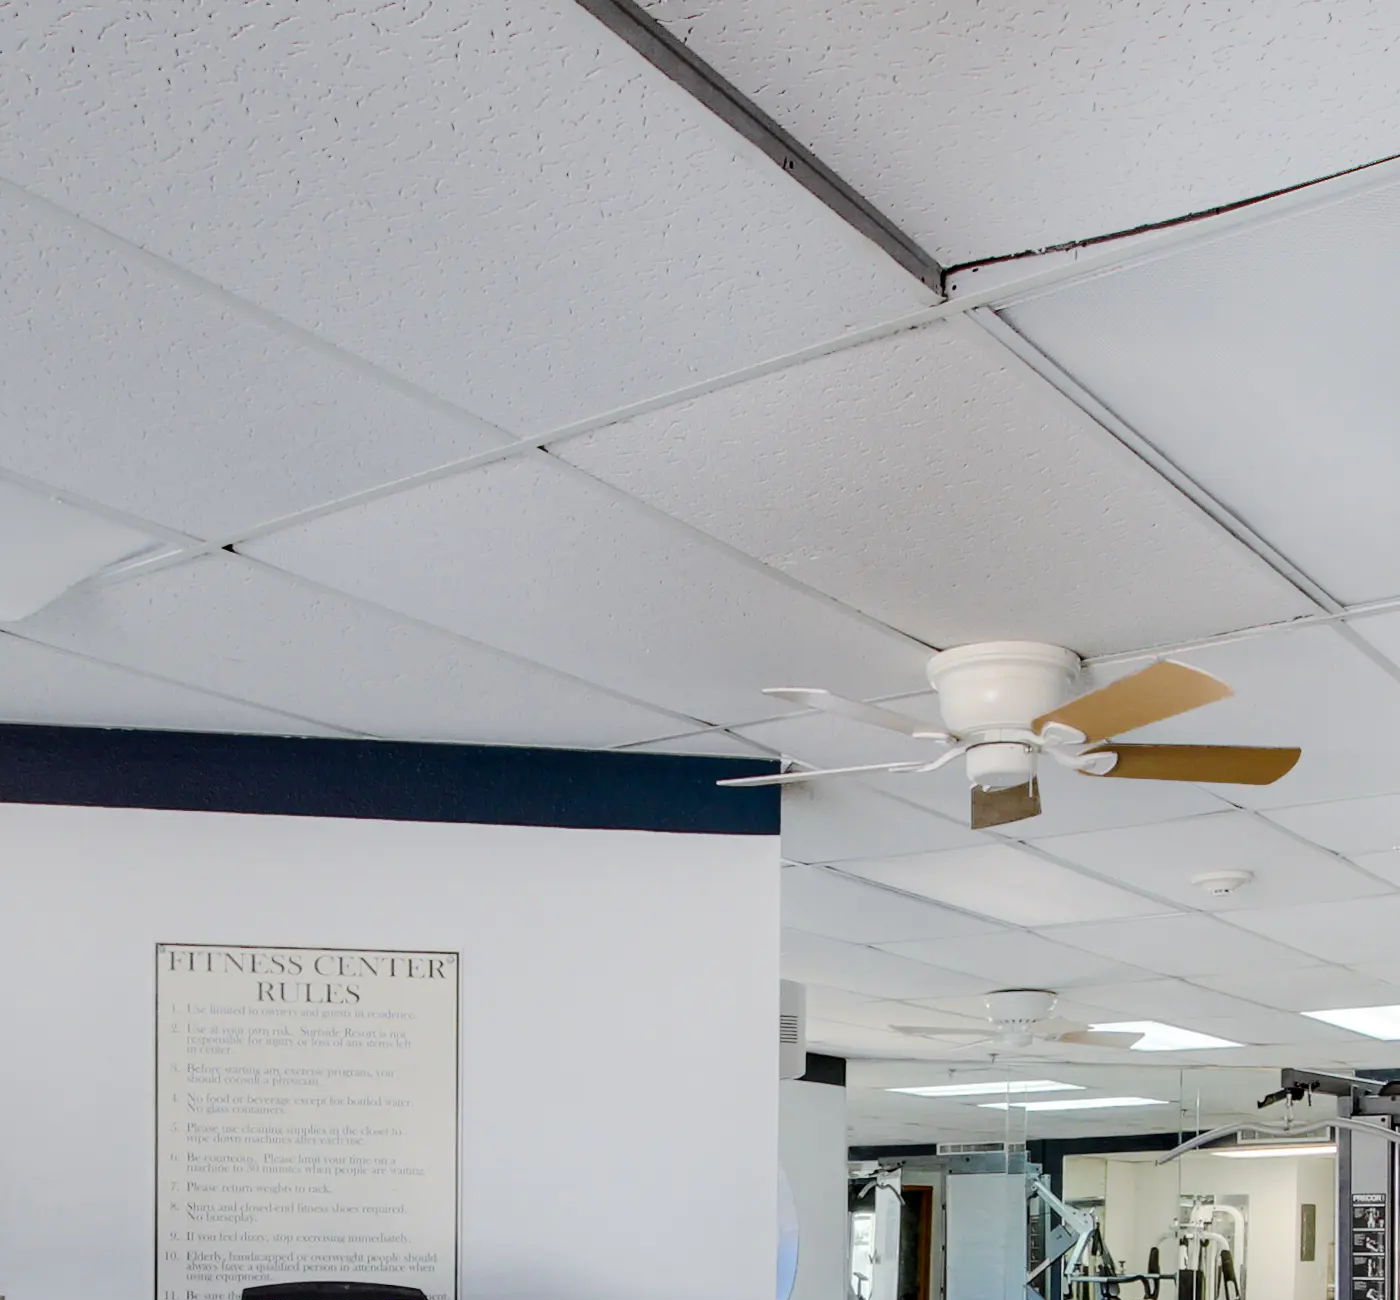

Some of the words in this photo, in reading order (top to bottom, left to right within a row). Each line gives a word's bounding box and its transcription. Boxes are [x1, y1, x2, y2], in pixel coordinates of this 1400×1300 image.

[168, 951, 304, 976] FITNESS
[314, 955, 447, 980] CENTER
[257, 981, 361, 1004] RULES
[209, 1004, 245, 1015] limited
[300, 1006, 318, 1017] and
[187, 1063, 220, 1073] Before
[225, 1065, 260, 1075] starting
[264, 1068, 280, 1076] any
[284, 1068, 322, 1076] exercise
[376, 1069, 394, 1078] you
[187, 1074, 221, 1084] should
[207, 1094, 229, 1103] food
[247, 1095, 289, 1105] beverage
[294, 1097, 326, 1106] except
[330, 1096, 345, 1105] for
[348, 1096, 382, 1106] bottled
[206, 1104, 228, 1114] glass
[232, 1104, 286, 1113] containers.
[187, 1122, 218, 1133] Please
[241, 1124, 283, 1135] cleaning
[286, 1124, 326, 1136] supplies
[343, 1125, 357, 1135] the
[360, 1126, 389, 1136] closet
[186, 1134, 210, 1144] wipe
[214, 1134, 242, 1143] down
[245, 1134, 291, 1144] machines
[294, 1135, 316, 1144] after
[321, 1136, 342, 1145] each
[264, 1153, 293, 1163] Please
[298, 1155, 320, 1164] limit
[324, 1157, 346, 1165] your
[349, 1155, 371, 1164] time
[187, 1163, 229, 1172] machine
[262, 1165, 301, 1173] minutes
[305, 1165, 331, 1174] when
[335, 1166, 366, 1176] people
[187, 1182, 218, 1192] Please
[222, 1184, 253, 1192] return
[256, 1184, 291, 1193] weights
[187, 1202, 214, 1212] Shirts
[218, 1202, 237, 1212] and
[240, 1203, 294, 1213] closed-end
[298, 1203, 328, 1213] fitness
[331, 1203, 359, 1213] shoes
[362, 1204, 407, 1217] required.
[206, 1212, 258, 1223] horseplay.
[197, 1234, 216, 1242] you
[220, 1232, 237, 1241] feel
[241, 1232, 269, 1242] dizzy,
[273, 1234, 293, 1243] stop
[297, 1234, 345, 1243] exercising
[348, 1232, 411, 1243] immediately.
[165, 1251, 179, 1261] 10.
[187, 1251, 226, 1262] Elderly,
[229, 1252, 294, 1263] handicapped
[311, 1252, 364, 1263] overweight
[367, 1253, 400, 1264] people
[404, 1253, 437, 1263] should
[186, 1261, 218, 1272] always
[222, 1262, 243, 1271] have
[257, 1262, 299, 1273] qualified
[303, 1263, 337, 1273] person
[353, 1263, 404, 1272] attendance
[408, 1263, 435, 1272] when
[186, 1273, 212, 1281] using
[216, 1272, 272, 1282] equipment.
[165, 1291, 179, 1300] 11.
